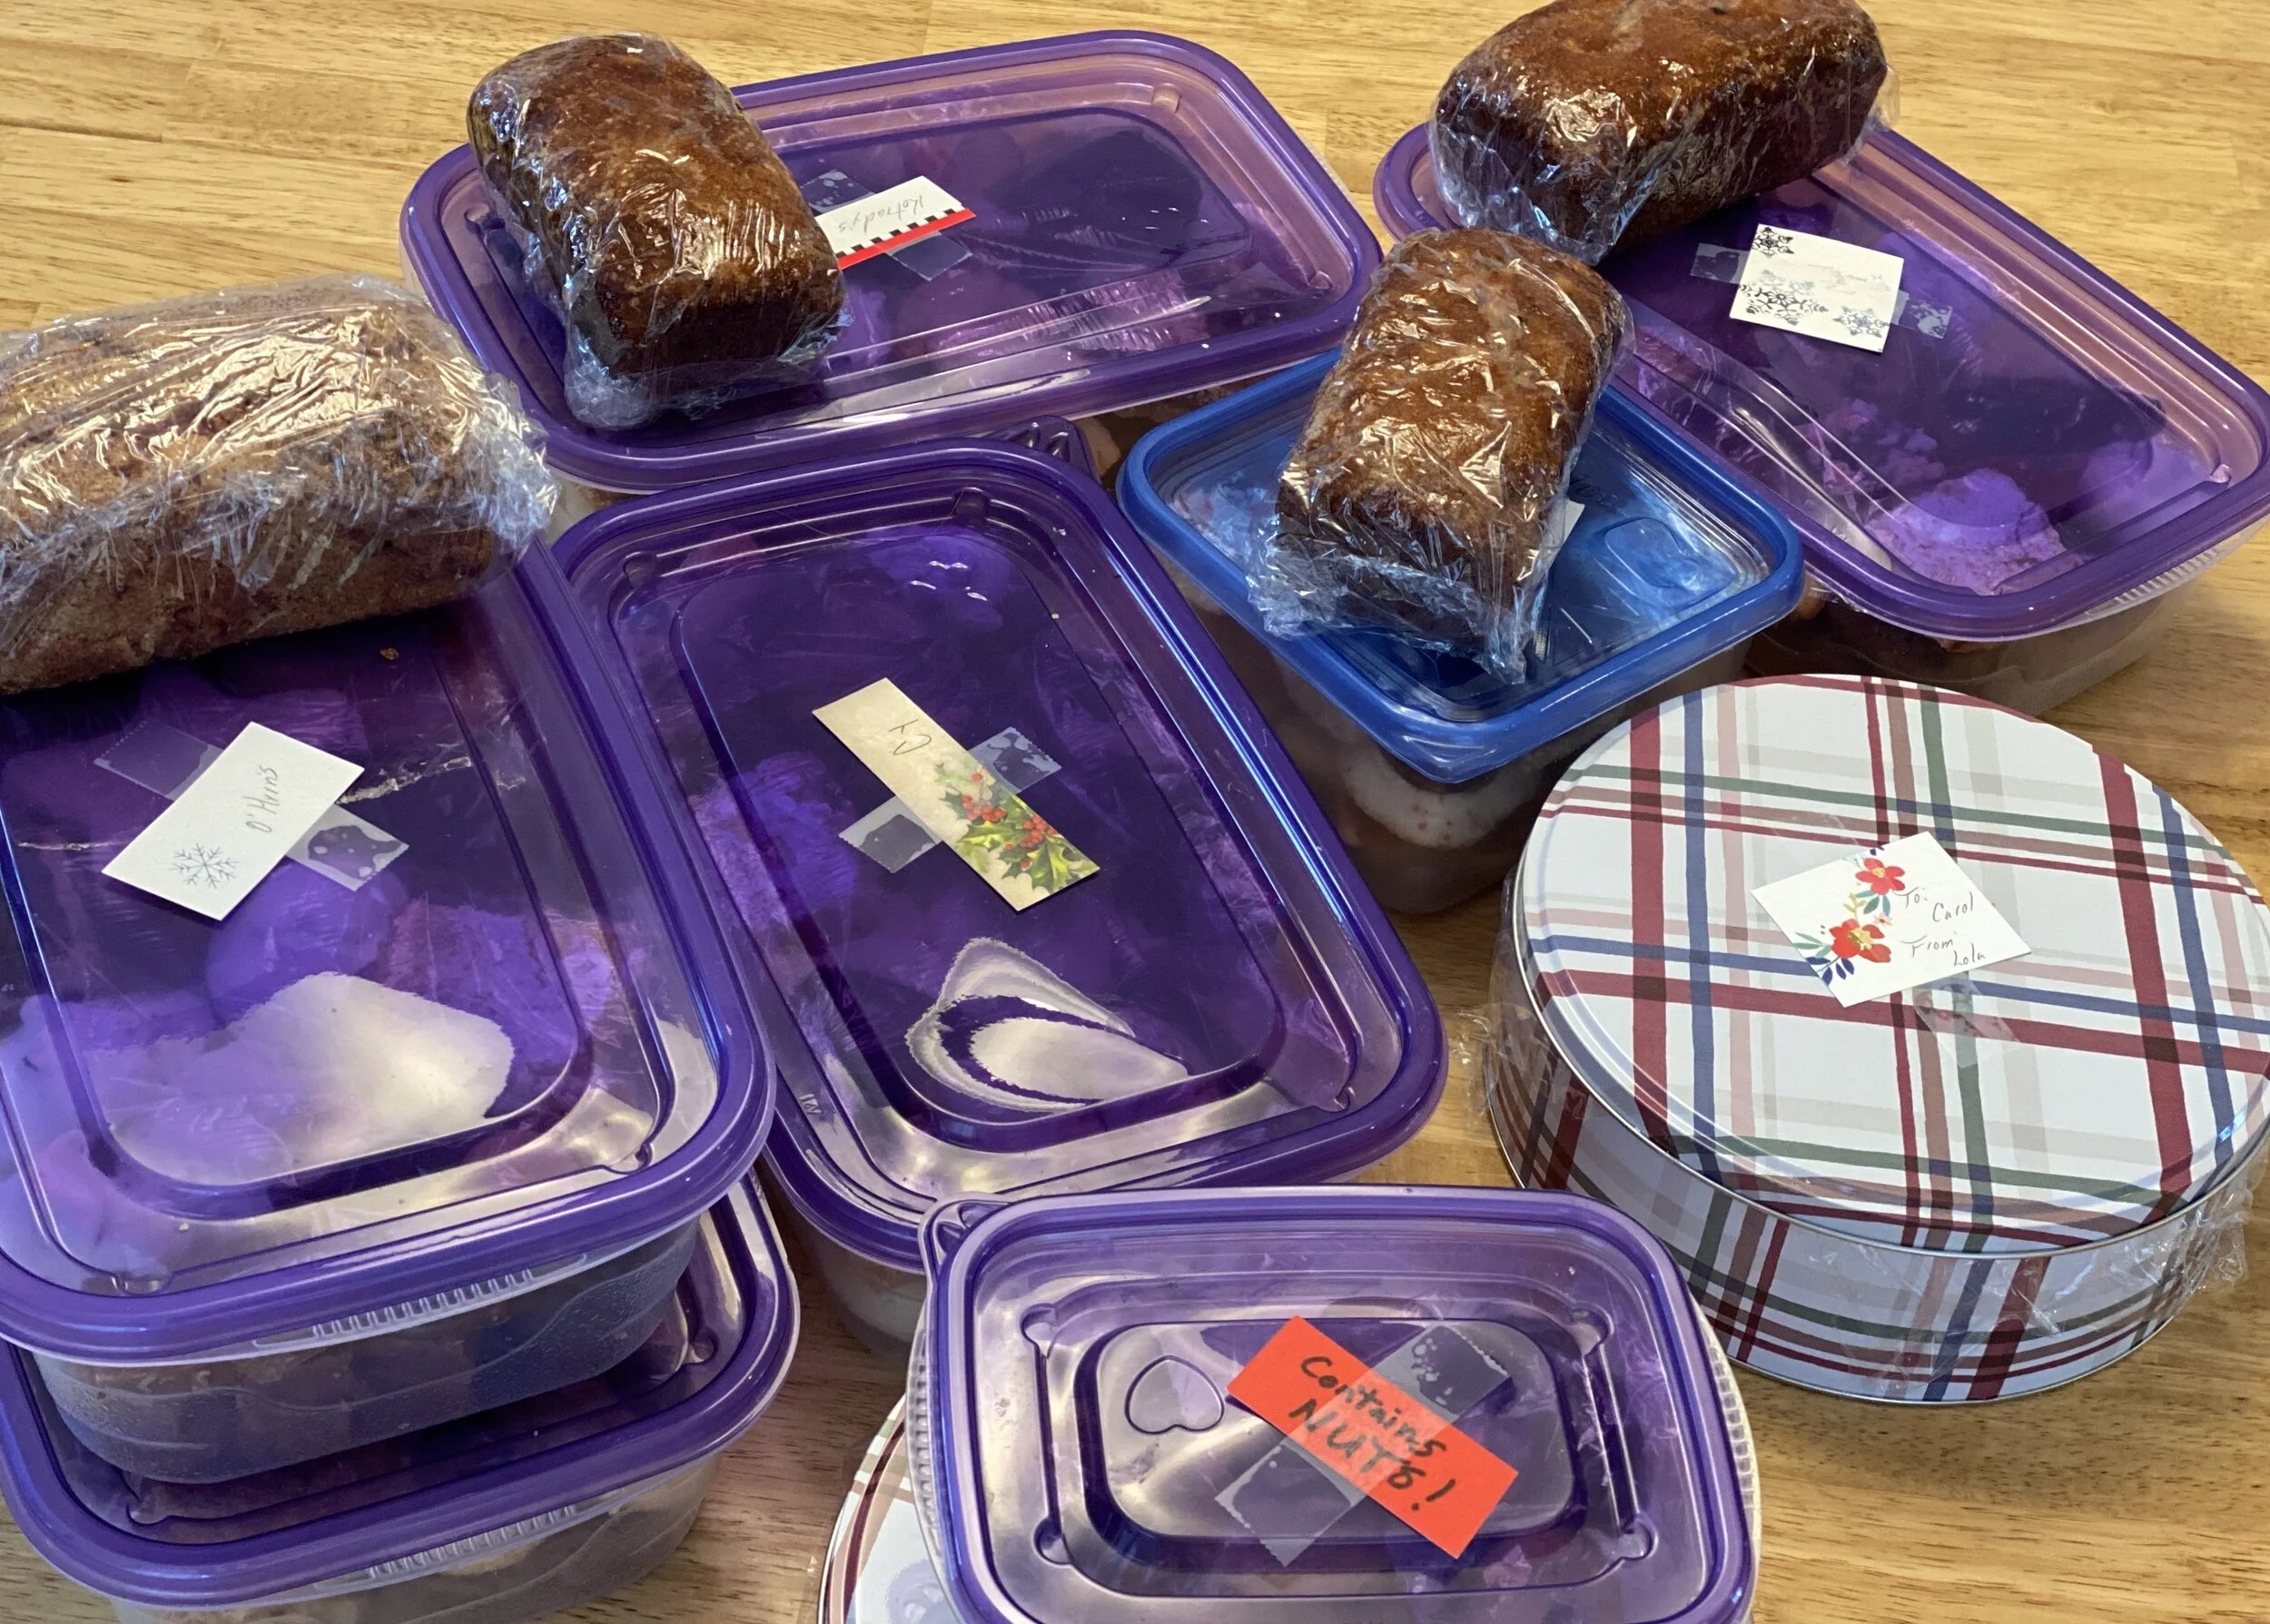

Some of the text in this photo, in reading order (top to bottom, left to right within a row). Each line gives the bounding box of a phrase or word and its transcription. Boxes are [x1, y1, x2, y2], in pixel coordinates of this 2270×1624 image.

[1932, 891, 1975, 923] Carol
[1952, 943, 1988, 968] Lola
[1300, 1355, 1447, 1458] Contains
[1288, 1399, 1456, 1511] NUTS!
